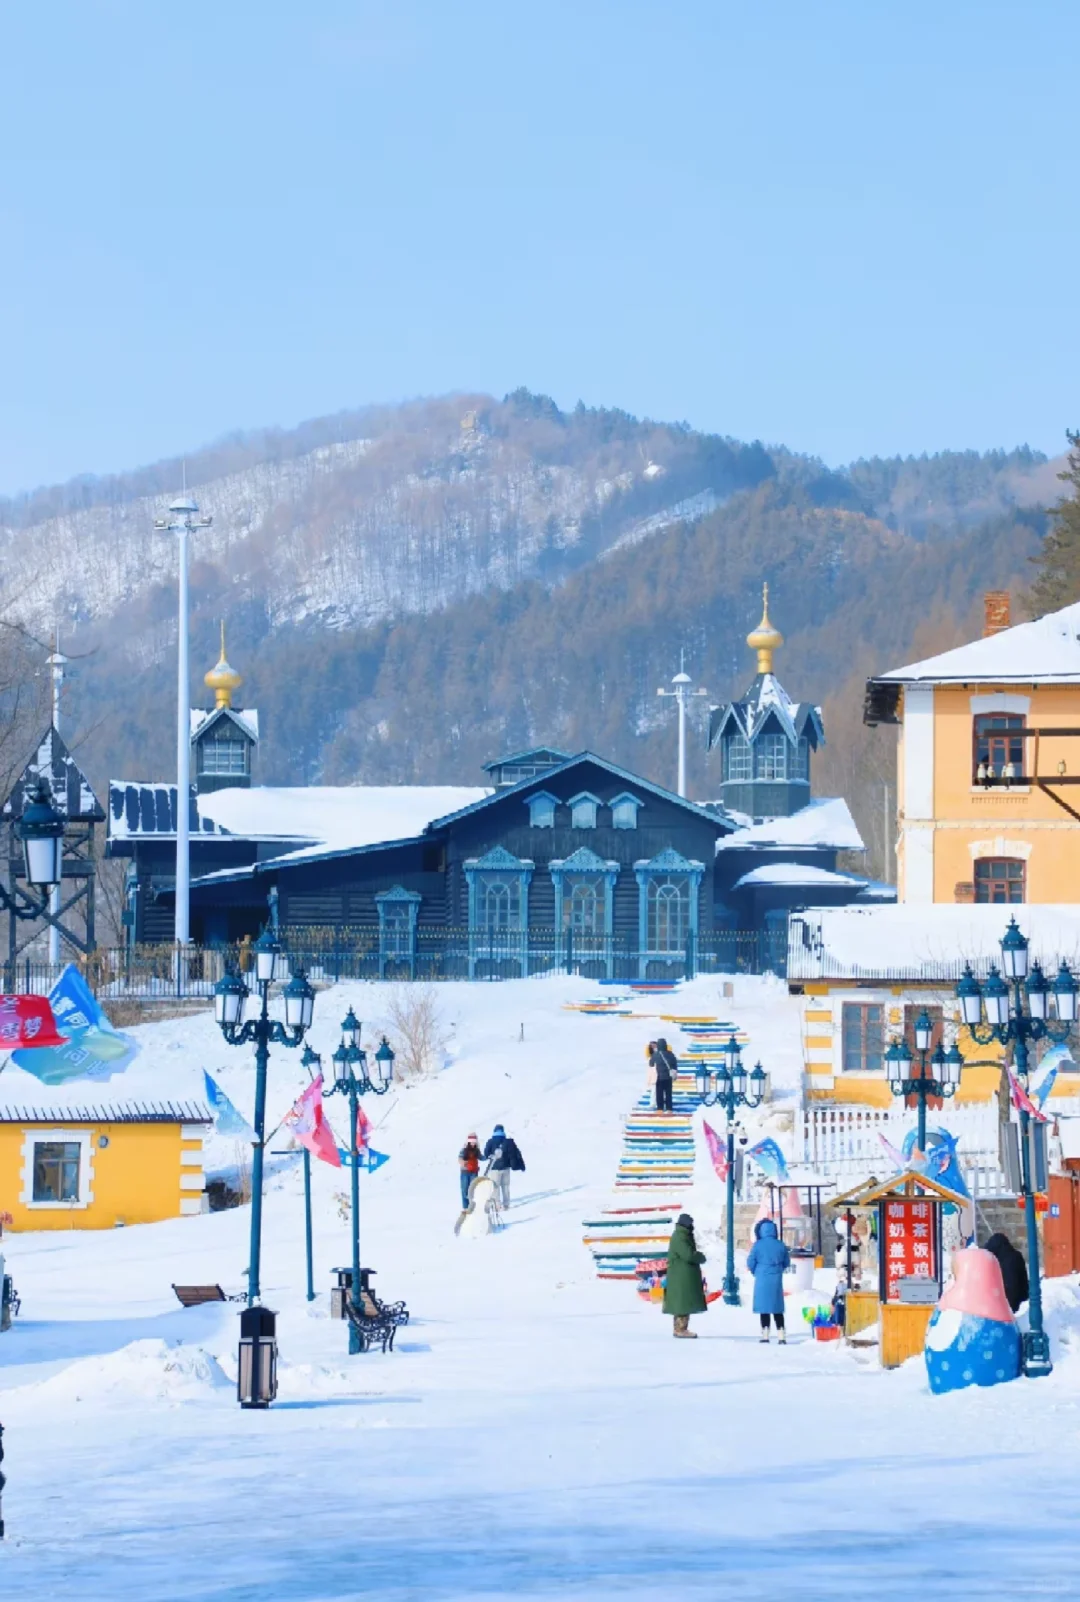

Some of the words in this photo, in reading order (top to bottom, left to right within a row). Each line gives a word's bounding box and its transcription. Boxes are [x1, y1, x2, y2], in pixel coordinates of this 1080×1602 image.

[888, 1202, 928, 1218] 咖啡
[889, 1223, 928, 1238] 奶茶
[889, 1242, 929, 1258] 盖饭
[889, 1262, 929, 1277] 炸鸡
